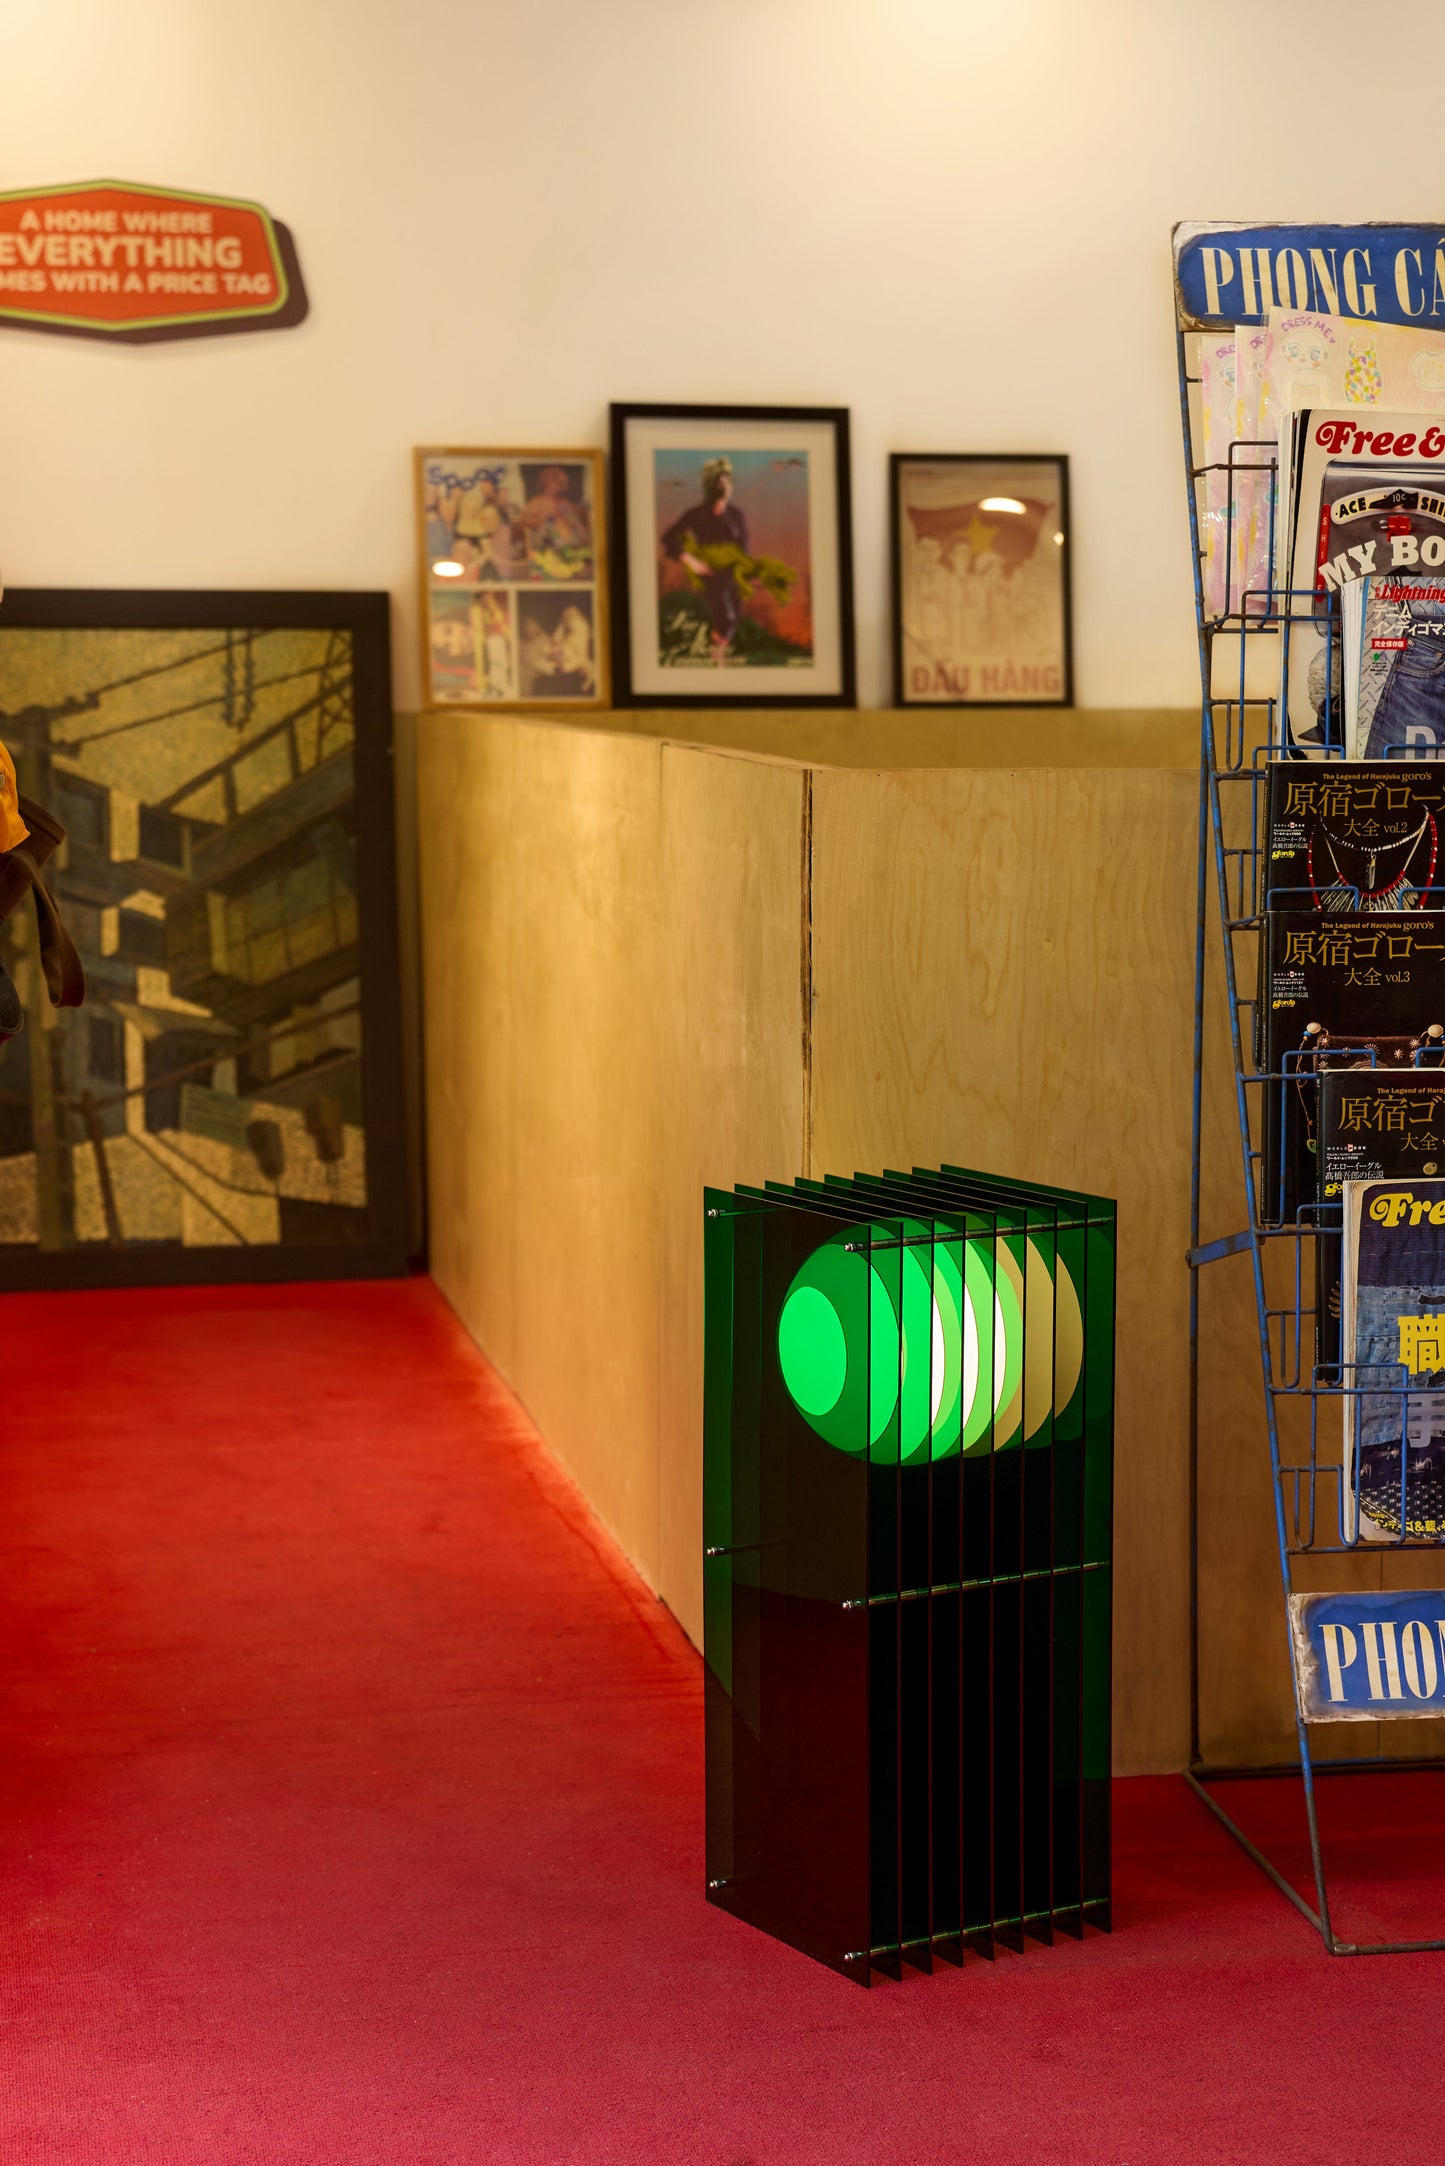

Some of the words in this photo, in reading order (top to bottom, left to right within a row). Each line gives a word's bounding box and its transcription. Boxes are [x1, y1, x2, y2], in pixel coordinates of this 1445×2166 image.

[20, 210, 40, 231] A
[44, 210, 118, 232] HOME
[122, 211, 212, 234] WHERE
[0, 234, 242, 269] EVERYTHING
[50, 271, 118, 293] WITH
[123, 272, 144, 293] A
[148, 273, 216, 294] PRICE
[222, 273, 271, 295] TAG
[1198, 247, 1378, 316] PHONG
[1281, 316, 1312, 332] DRESS
[1315, 321, 1333, 338] ME
[1338, 497, 1367, 518] ACE
[1420, 497, 1445, 517] SHI
[1318, 540, 1377, 592] MY
[1390, 535, 1445, 567] BO
[1373, 601, 1412, 619] デニム
[1336, 773, 1360, 782] Legend
[1283, 781, 1445, 817] 原宿ゴロー
[1344, 818, 1380, 837] 大全
[1383, 822, 1408, 834] vol.2
[1335, 922, 1360, 930] Legend
[1371, 922, 1402, 930] Harajuku
[1403, 921, 1435, 932] goro's
[1282, 930, 1445, 966] 原宿ゴロー
[1344, 967, 1382, 987] 大全
[1385, 971, 1411, 983] vol.3
[1338, 1095, 1445, 1132] 原宿ゴ
[1401, 1132, 1439, 1151] 大全
